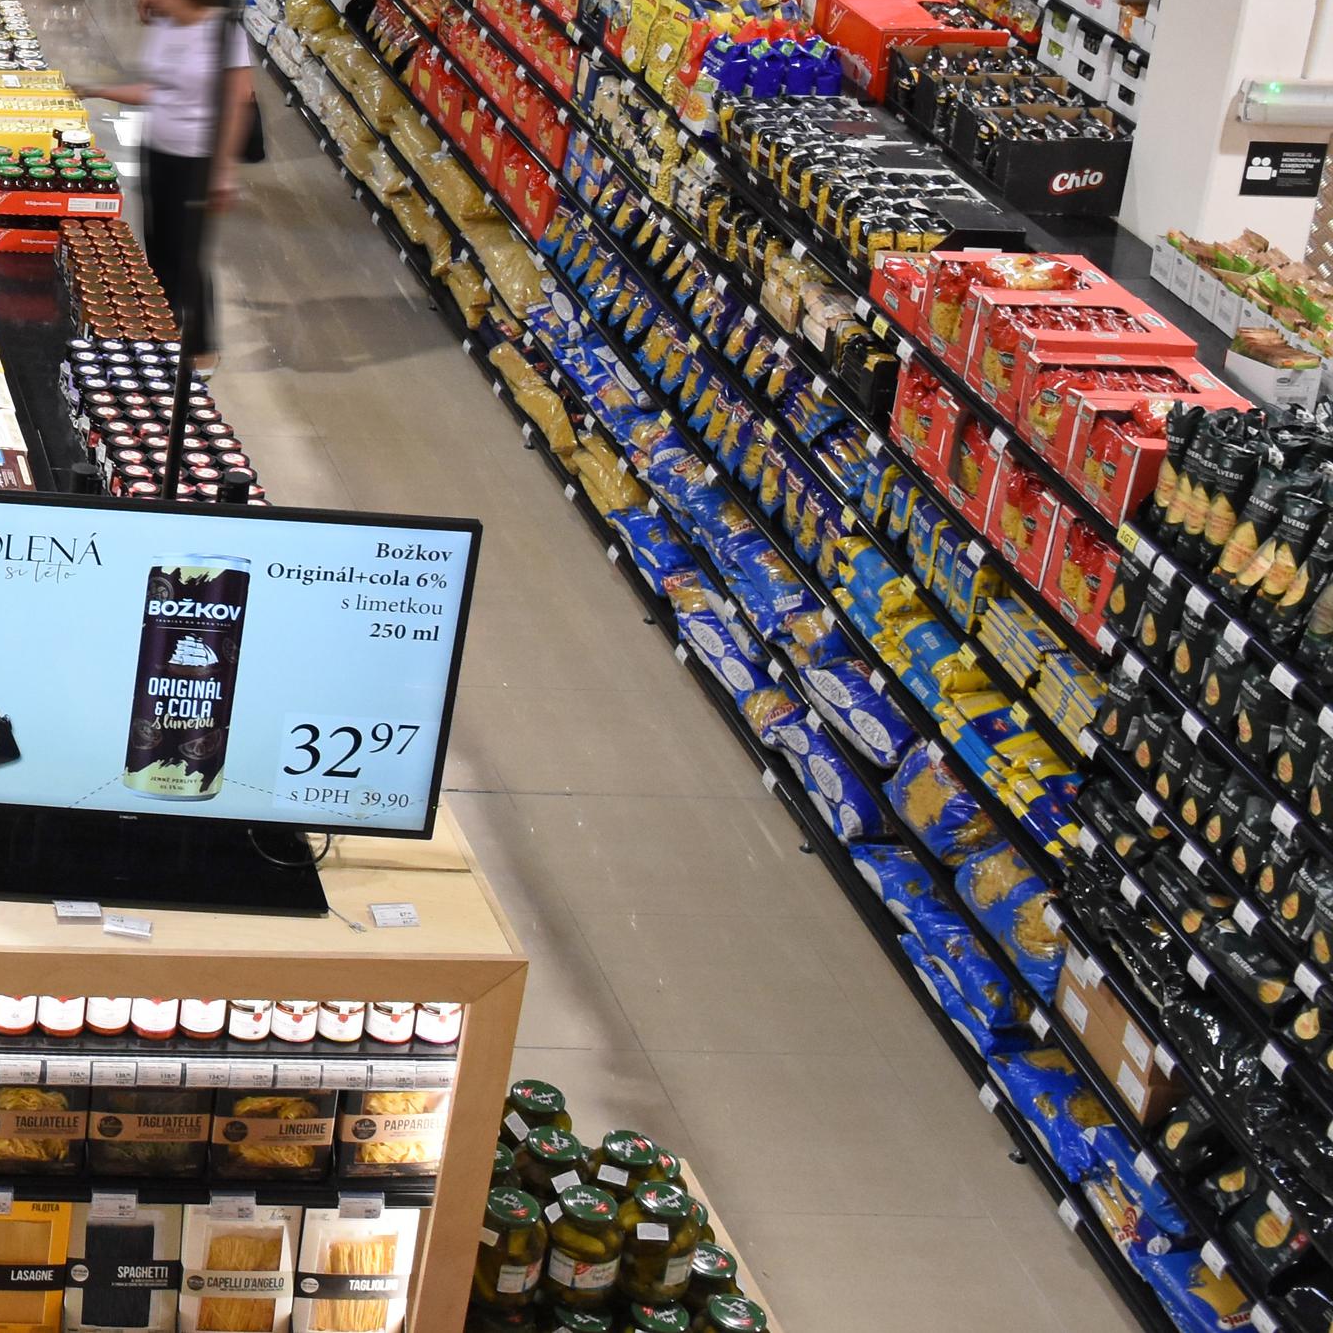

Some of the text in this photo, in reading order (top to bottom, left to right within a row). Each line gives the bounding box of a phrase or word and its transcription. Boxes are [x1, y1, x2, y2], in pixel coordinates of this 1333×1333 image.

[1049, 169, 1104, 196] Chio
[1249, 496, 1279, 514] ELVERDE
[1282, 516, 1310, 531] ELVERDE
[375, 542, 453, 564] Božkov
[267, 562, 448, 590] Originál+cola 6%
[148, 598, 242, 621] BOŽKOV
[341, 594, 443, 616] s limetkou
[369, 622, 440, 642] 250 ml
[148, 676, 222, 700] ORIGINÁL
[155, 698, 211, 718] & COLA
[283, 722, 421, 780] 32 97
[291, 786, 409, 808] s DPH 39,90
[15, 1116, 79, 1129] TAGLIATELLE
[137, 1116, 203, 1129] TAGLIATELLE
[279, 1122, 327, 1135] LINGUINE
[31, 1202, 60, 1213] FILOTEA
[11, 1269, 53, 1282] LASAGNE
[117, 1266, 169, 1279] SPAGHETTI
[206, 1276, 285, 1289] CAPELLI D'ANGELO
